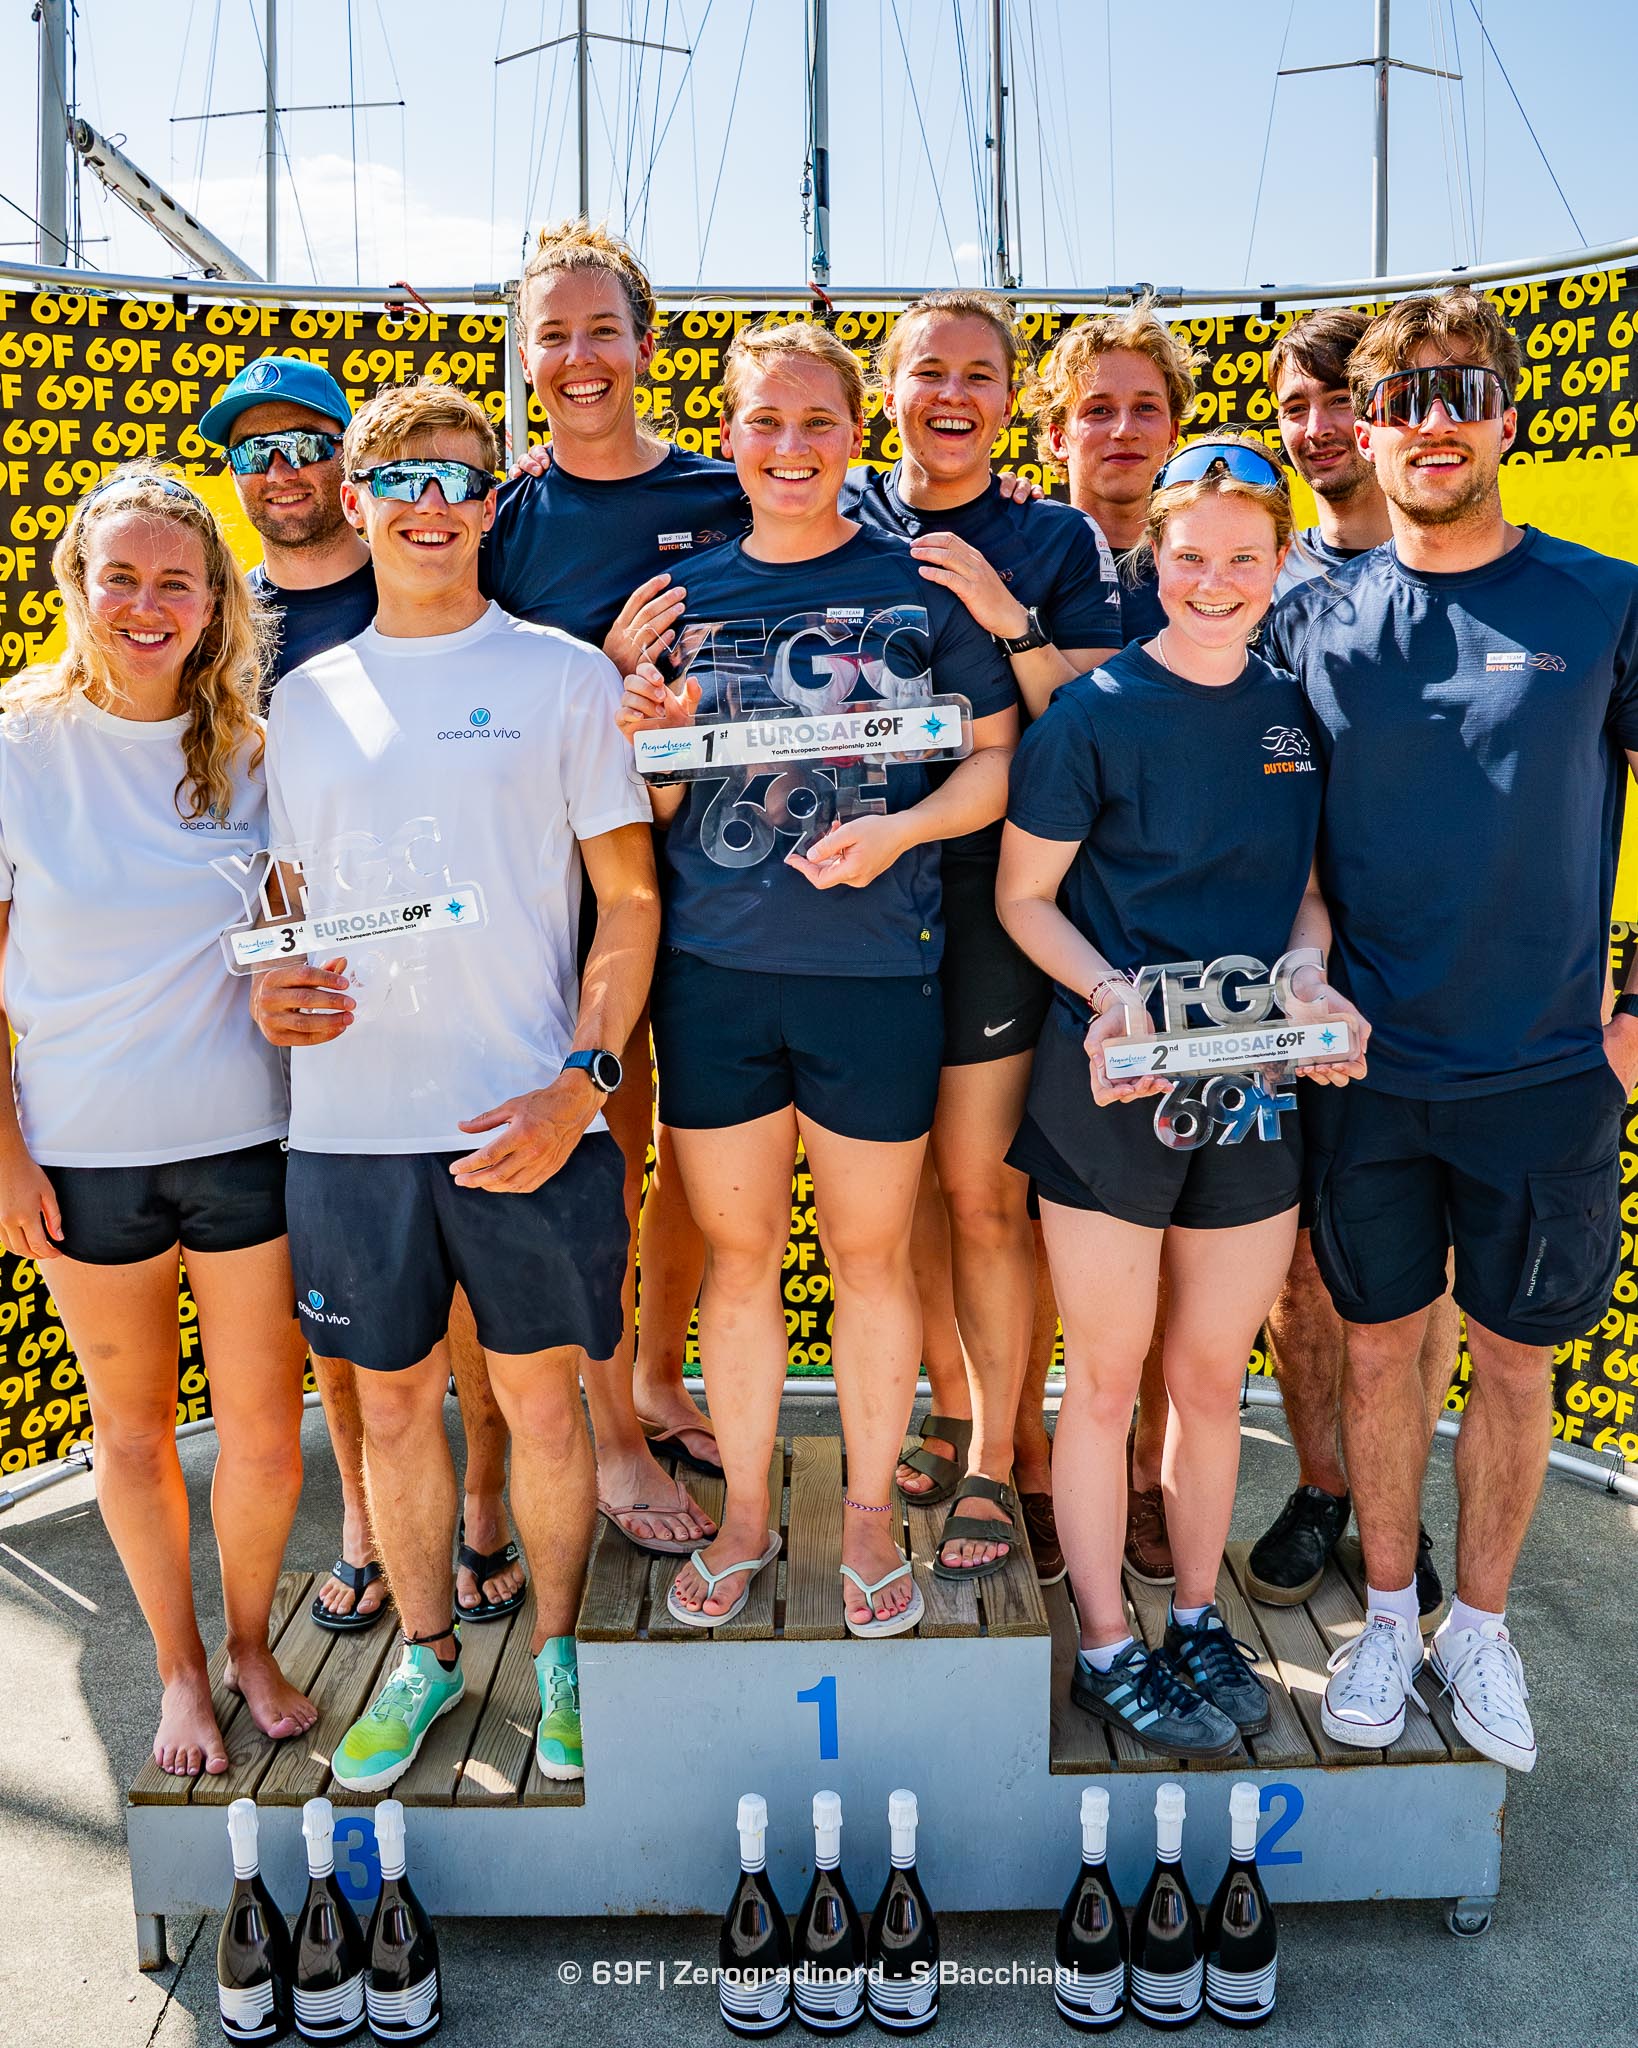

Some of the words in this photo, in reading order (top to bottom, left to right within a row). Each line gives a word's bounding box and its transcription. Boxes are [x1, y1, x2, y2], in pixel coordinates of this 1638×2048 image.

[1559, 268, 1626, 309] 69F
[31, 292, 107, 326] 69F
[120, 300, 194, 332] 69F
[206, 305, 279, 336] 69F
[291, 310, 363, 339] 69F
[377, 313, 447, 341] 69F
[459, 315, 505, 343] 69
[1012, 312, 1061, 342] 9F
[0, 332, 73, 368] 69F
[86, 338, 160, 373] 69F
[172, 343, 245, 378] 69F
[1527, 317, 1595, 359] 69F
[342, 349, 414, 383] 69F
[424, 351, 495, 384] 69F
[649, 347, 720, 381] 69F
[1514, 364, 1551, 401] 9F
[1561, 355, 1629, 396] 69F
[37, 375, 113, 411] 69F
[125, 379, 199, 414] 69F
[634, 386, 671, 419] 9F
[684, 384, 725, 419] 69
[1181, 391, 1234, 426] 9F
[3, 419, 80, 454] 69F
[92, 422, 166, 457] 69F
[658, 427, 722, 457] 9F
[990, 426, 1028, 458] 9F
[1528, 405, 1596, 444] 69F
[10, 505, 77, 541] 69
[0, 546, 35, 581] 9F
[19, 591, 68, 627] 69
[0, 632, 44, 668] 9F
[437, 730, 490, 740] oceana
[493, 727, 521, 739] vivo
[771, 748, 790, 756] Youth
[791, 747, 820, 755] European
[821, 743, 865, 753] Championship
[1153, 1072, 1298, 1152] 69F
[790, 1206, 819, 1235] 69
[782, 1241, 817, 1271] 9F
[0, 1292, 35, 1336] 9F
[326, 1312, 351, 1326] vivo
[784, 1309, 817, 1338] 9F
[1584, 1308, 1638, 1347] 9F
[788, 1342, 832, 1366] 69
[1553, 1338, 1593, 1371] 9F
[0, 1367, 41, 1410] 9F
[1566, 1380, 1636, 1425] 69F
[21, 1392, 91, 1440] 69F
[175, 1396, 206, 1427] 9F
[1551, 1414, 1585, 1443] 9F
[0, 1439, 47, 1478] 9F
[1592, 1426, 1638, 1463] 69
[796, 1675, 839, 1760] 1
[1255, 1783, 1304, 1866] 2
[332, 1816, 383, 1901] 3
